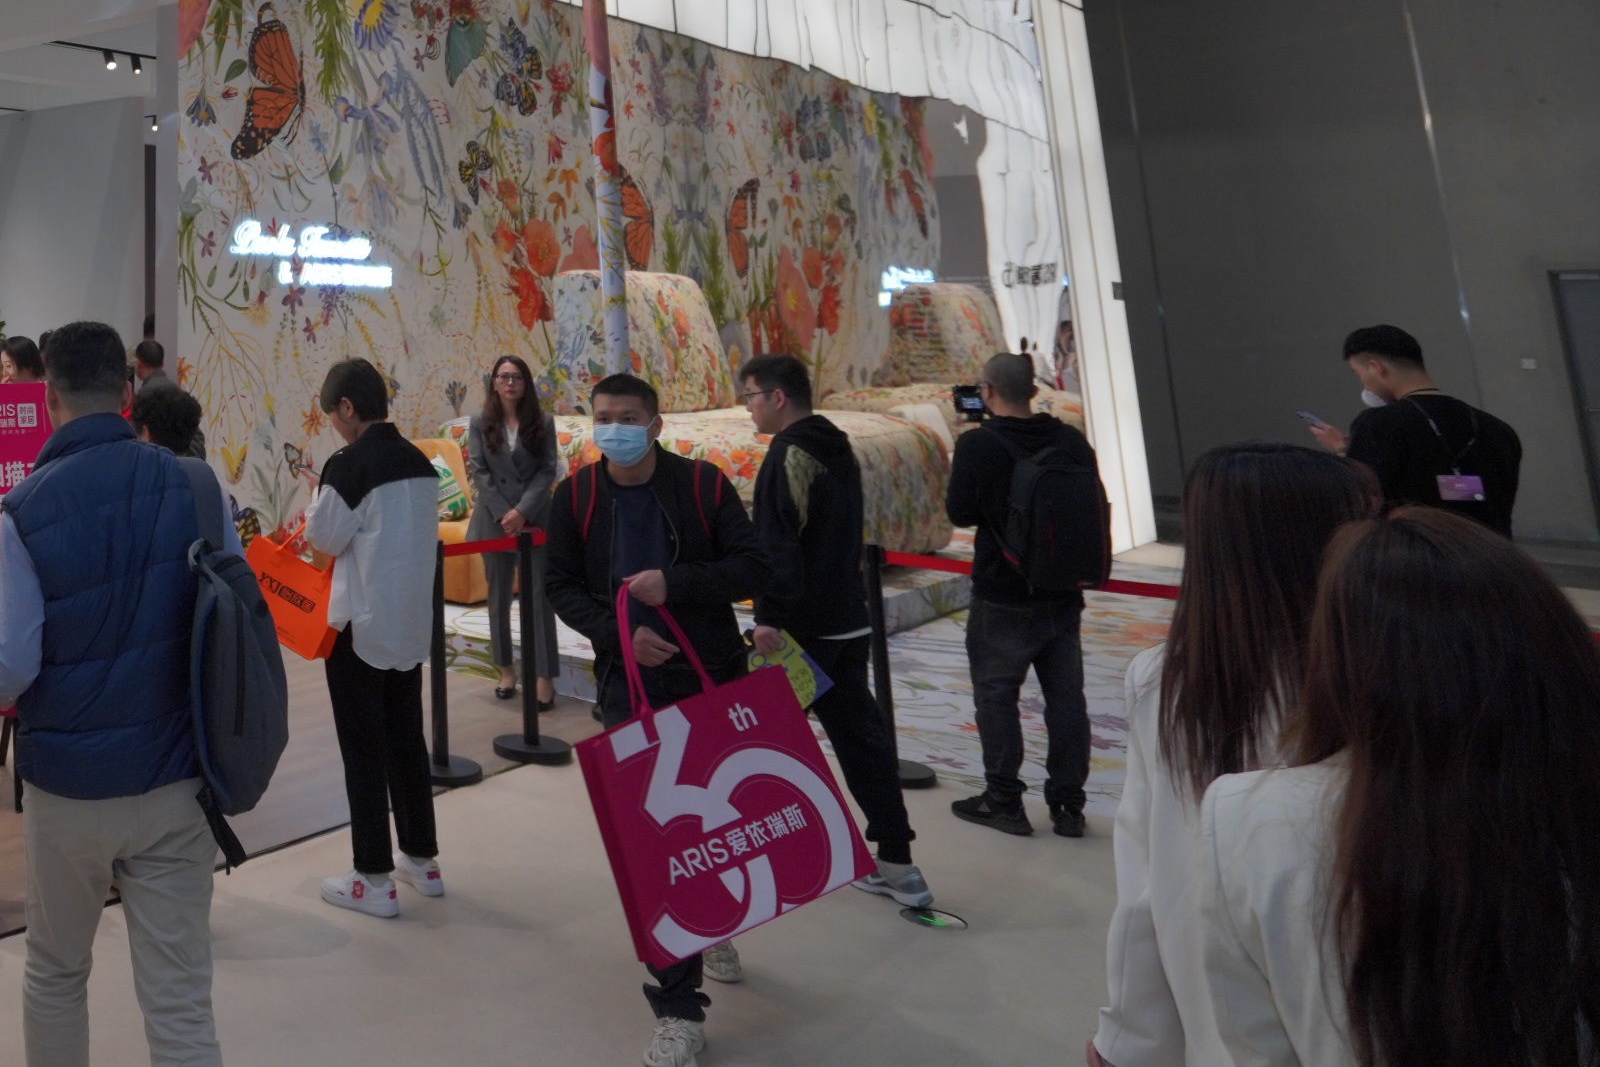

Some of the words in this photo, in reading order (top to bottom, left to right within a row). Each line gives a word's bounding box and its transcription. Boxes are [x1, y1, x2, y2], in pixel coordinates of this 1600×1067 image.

[668, 838, 731, 885] ARIS
[724, 803, 808, 857] 爱依瑞斯
